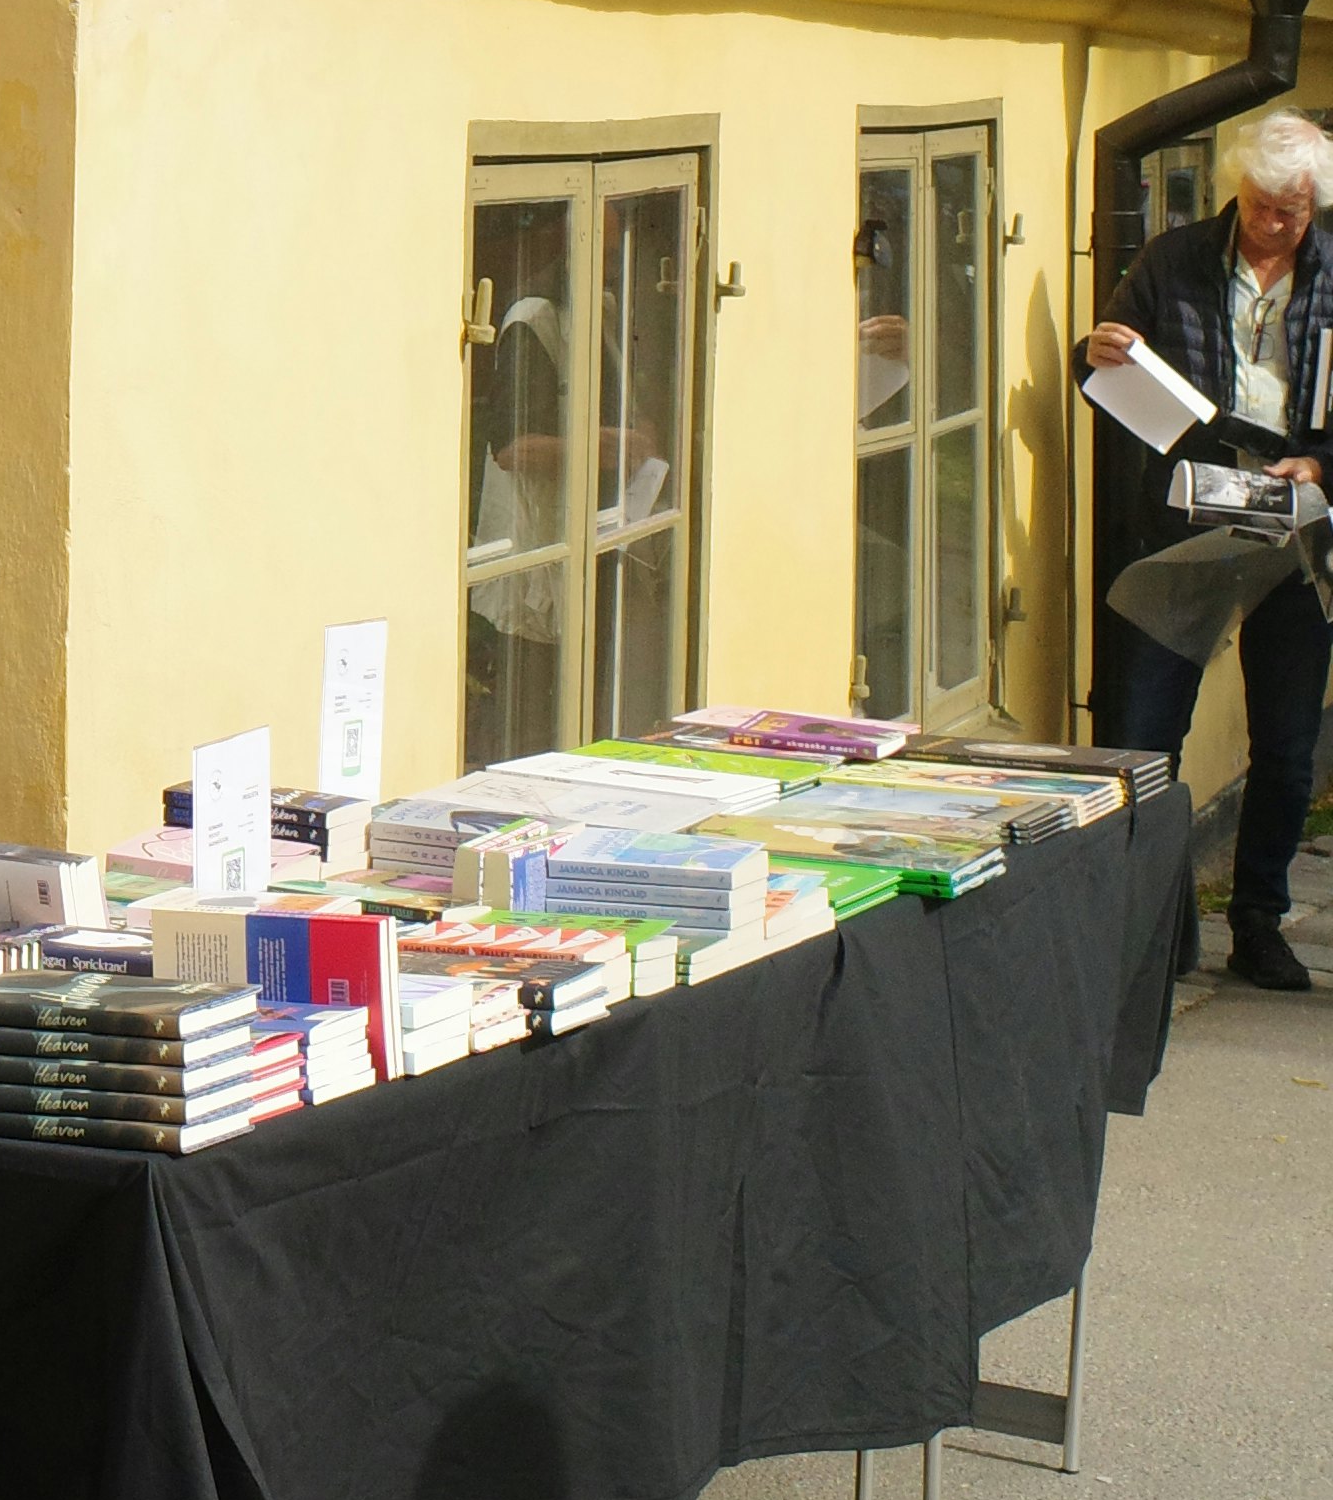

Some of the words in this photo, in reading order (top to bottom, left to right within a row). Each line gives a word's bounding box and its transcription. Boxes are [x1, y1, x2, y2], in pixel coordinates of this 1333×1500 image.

[558, 865, 604, 877] JAMAICA
[607, 868, 650, 879] KINCAID
[556, 884, 602, 896] JAMAICA
[604, 887, 647, 899] KINCAID
[73, 956, 128, 973] Spricktand
[37, 1009, 87, 1027] Heaven
[37, 1034, 89, 1053] Heaven
[34, 1065, 86, 1084] Heaven
[36, 1091, 89, 1111] Heaven
[33, 1118, 85, 1138] Heaven
